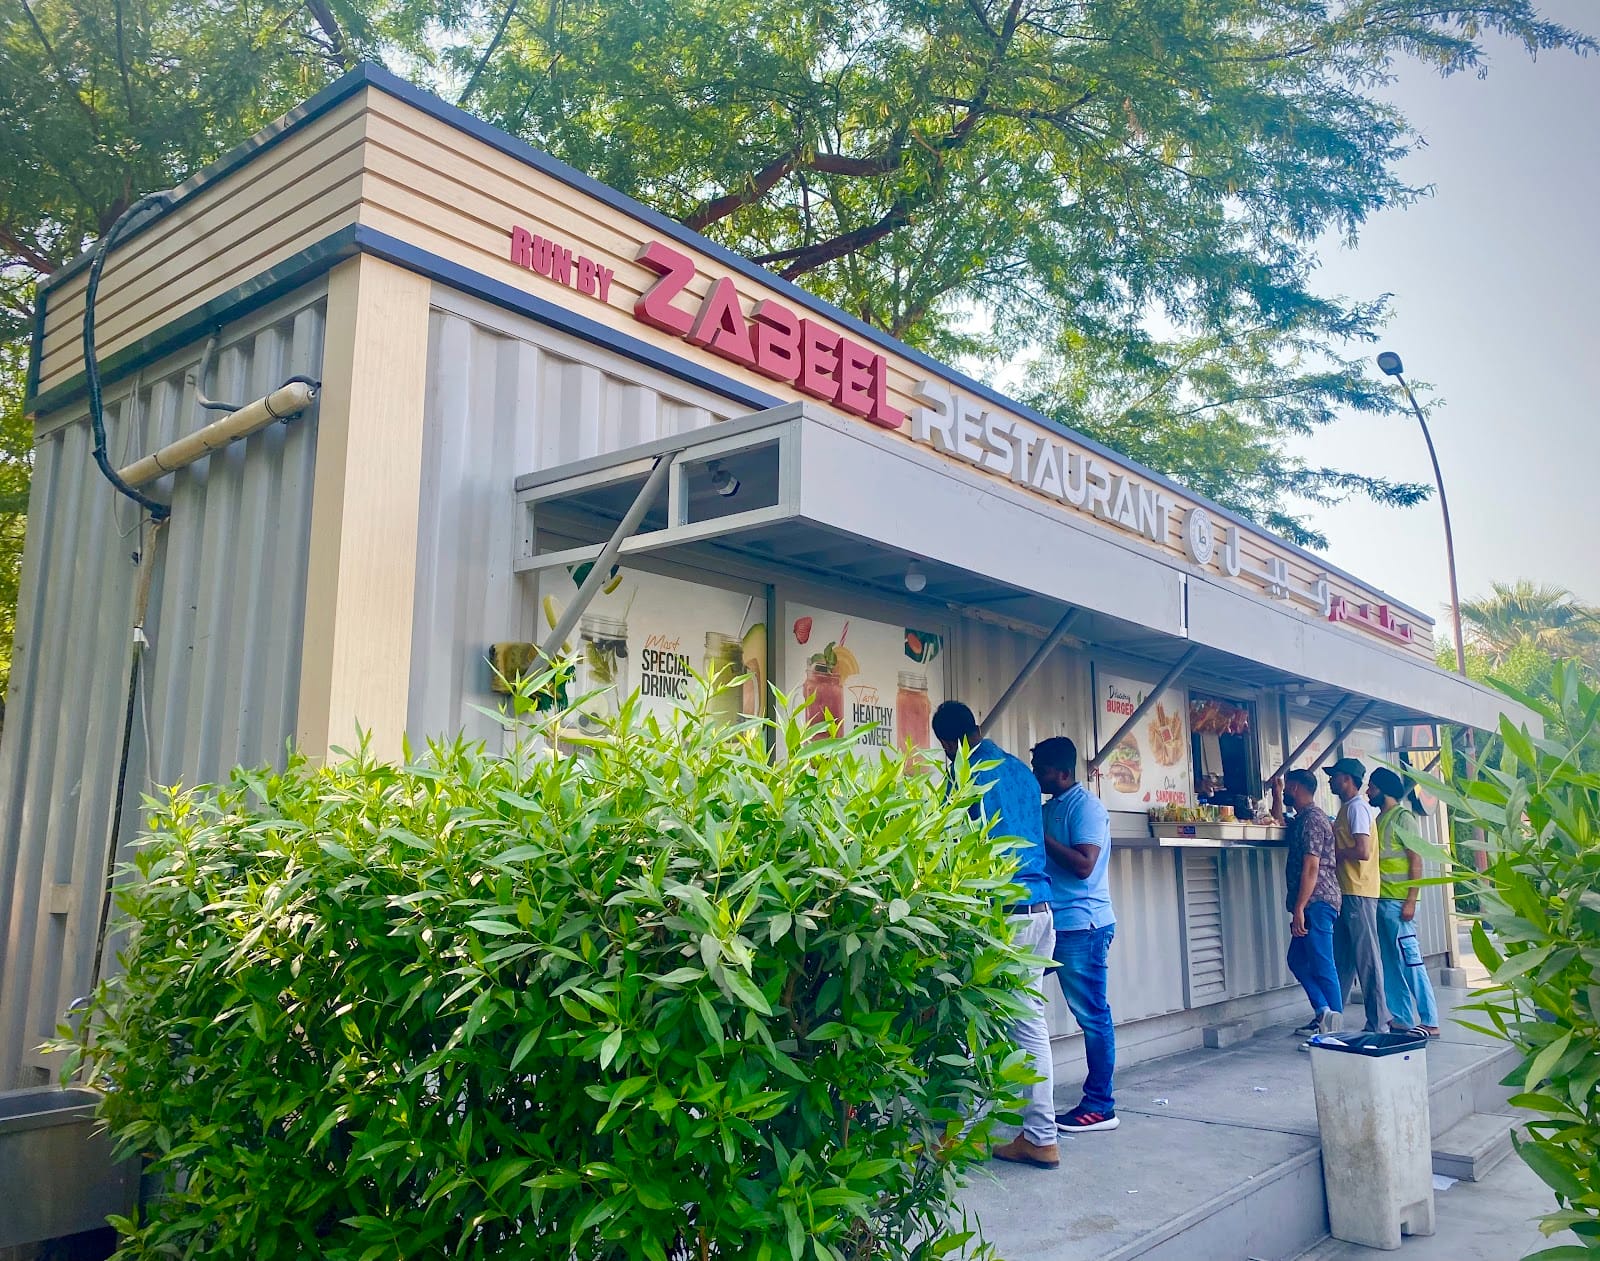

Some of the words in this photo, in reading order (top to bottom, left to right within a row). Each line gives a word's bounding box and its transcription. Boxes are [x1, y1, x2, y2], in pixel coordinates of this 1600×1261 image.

[511, 225, 572, 287] RUN
[577, 255, 615, 303] BY
[633, 240, 906, 430] ZABEEL
[911, 380, 1177, 545] RESTAURANT
[641, 648, 693, 677] SPECIAL
[641, 672, 688, 700] DRINKS
[1106, 699, 1135, 716] BURGER
